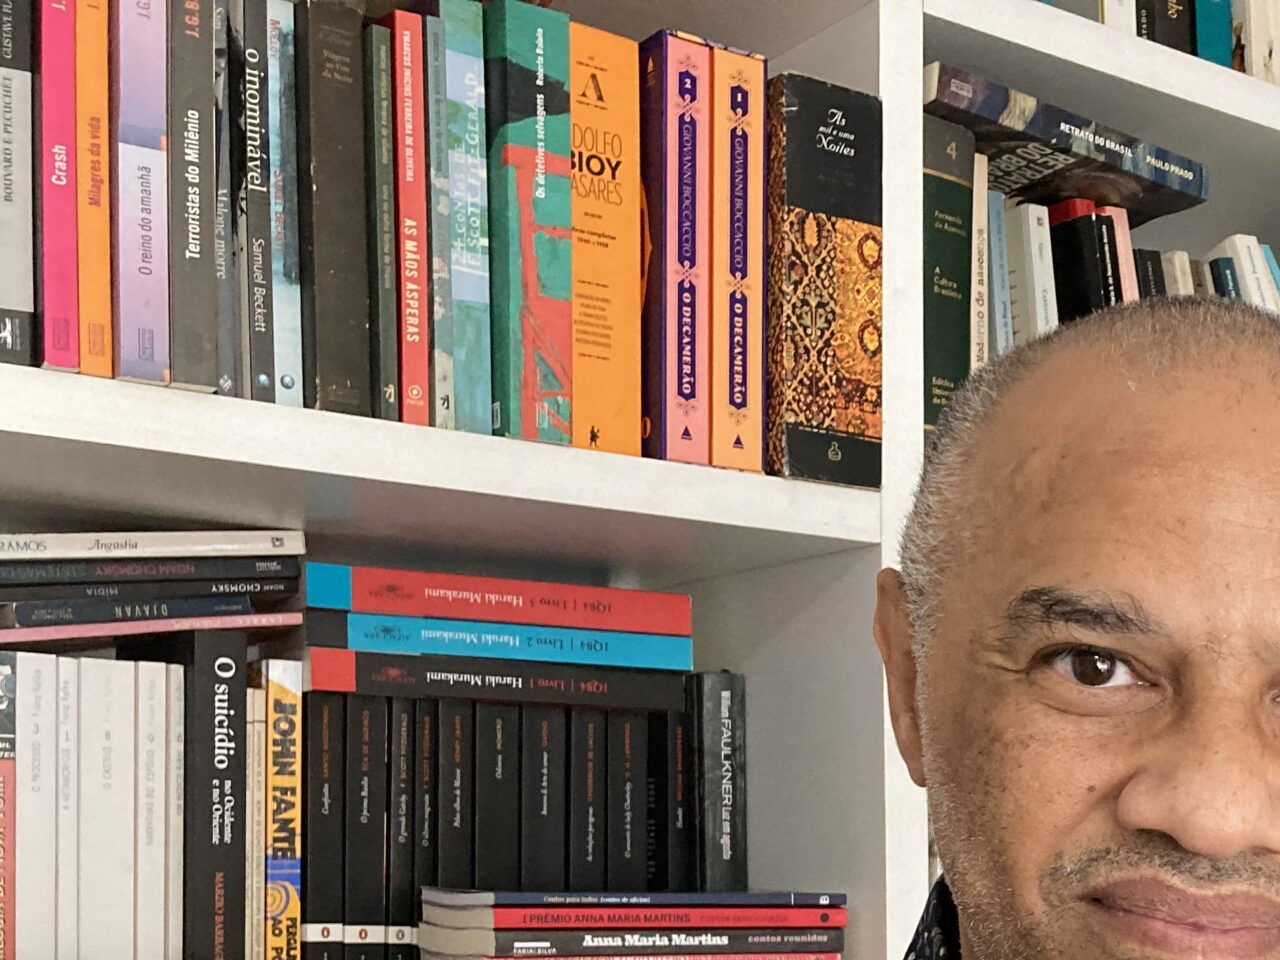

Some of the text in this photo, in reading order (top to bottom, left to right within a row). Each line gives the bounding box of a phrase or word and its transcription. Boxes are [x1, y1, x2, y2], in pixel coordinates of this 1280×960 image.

[51, 145, 66, 185] Crash
[88, 116, 103, 207] Milagres da vida
[246, 67, 267, 192] inominável
[535, 94, 547, 198] Os detetives selvagens
[1060, 122, 1194, 181] RETRATO DO BRASIL PAULO PRADO
[137, 166, 151, 275] O reino do amanhã
[184, 109, 200, 258] Terroristas do Milênio
[404, 218, 421, 342] AS MÃOS ÁSPERAS
[682, 78, 694, 394] 2 GIOVANNI BOCCACCIO O DECAMERÃO
[253, 238, 267, 332] Samuel Beckett
[115, 603, 168, 618] DJAVAN
[211, 583, 261, 593] CHOMSKY
[421, 628, 478, 644] Murakami
[482, 634, 520, 647] Haruki
[526, 636, 533, 647] 2
[536, 636, 564, 650] Livro
[214, 656, 236, 770] O suicídio
[272, 697, 298, 861] JOHN FANTE
[582, 935, 622, 947] Anna
[624, 934, 669, 947] Maria
[671, 934, 729, 946] Martins
[748, 934, 782, 944] contos
